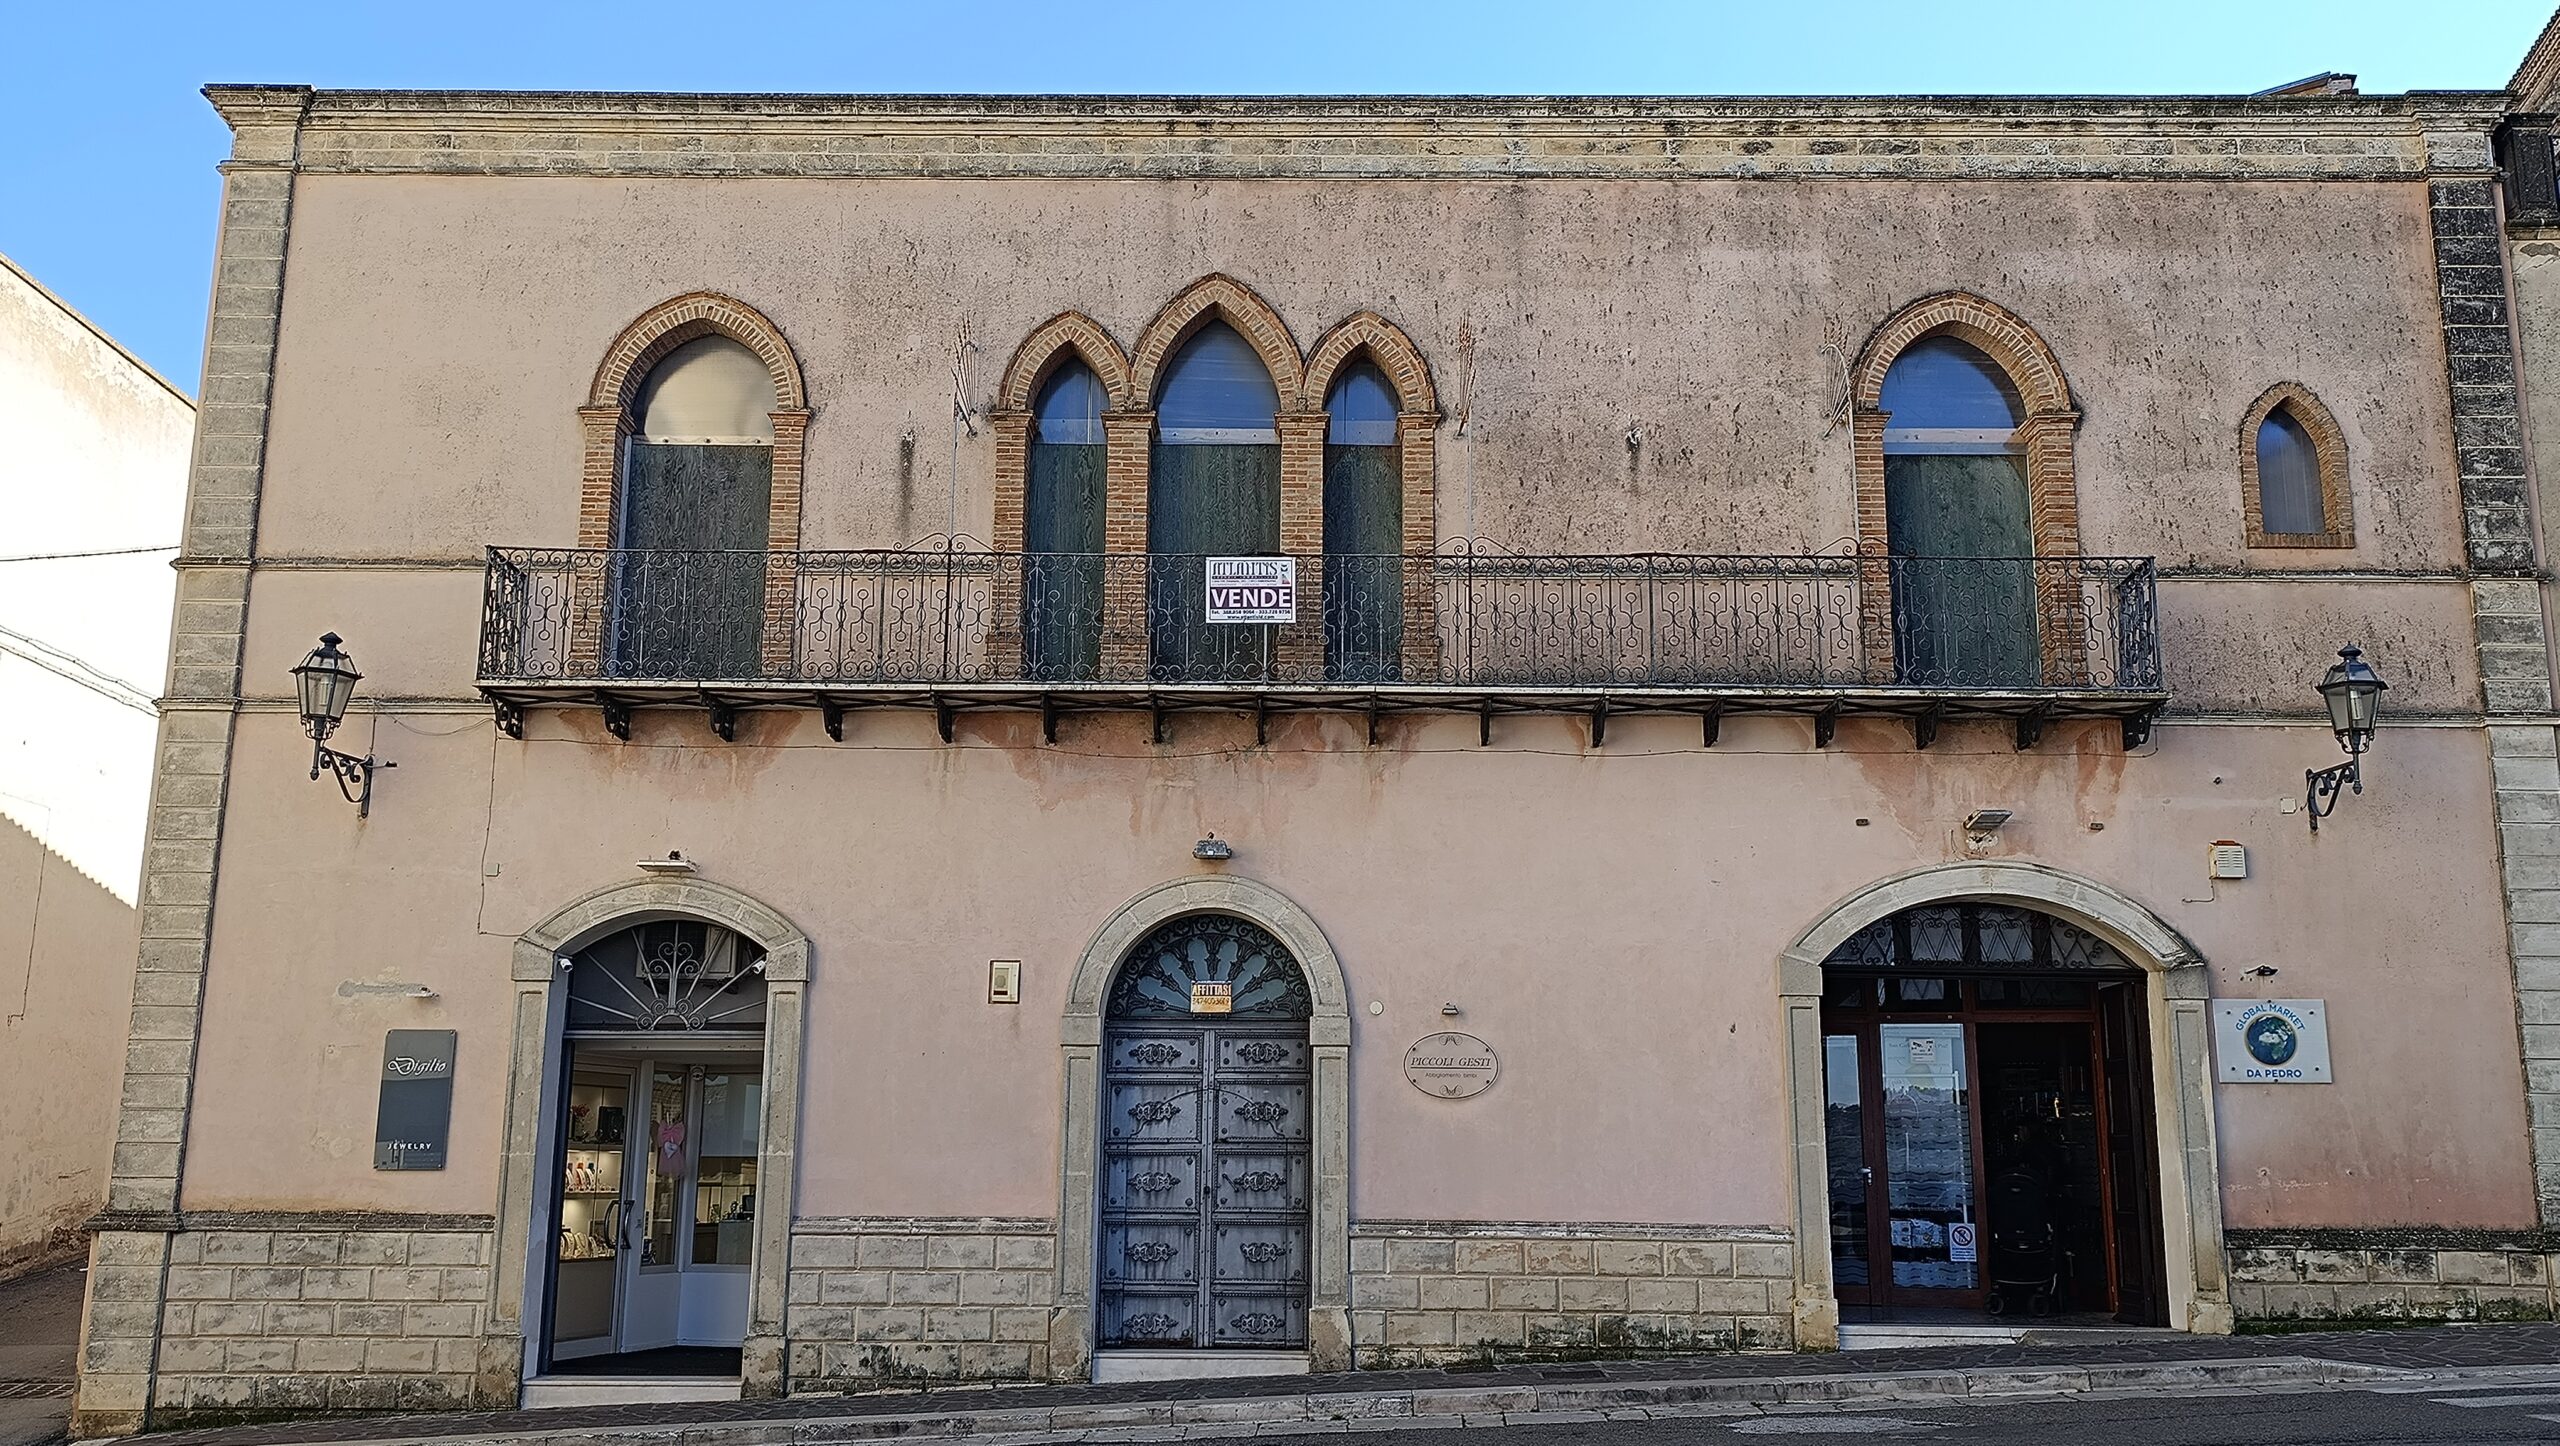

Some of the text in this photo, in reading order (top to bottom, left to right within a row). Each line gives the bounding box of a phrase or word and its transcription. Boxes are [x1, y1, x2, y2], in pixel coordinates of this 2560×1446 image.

[1211, 588, 1291, 608] VENDE
[1192, 984, 1231, 996] AFFITTASI
[2235, 1004, 2306, 1031] GLOBAL MARKET
[387, 1056, 447, 1076] Digilio
[1411, 1057, 1491, 1067] PICCOLI GESTI
[2246, 1069, 2302, 1078] DA PEDRO
